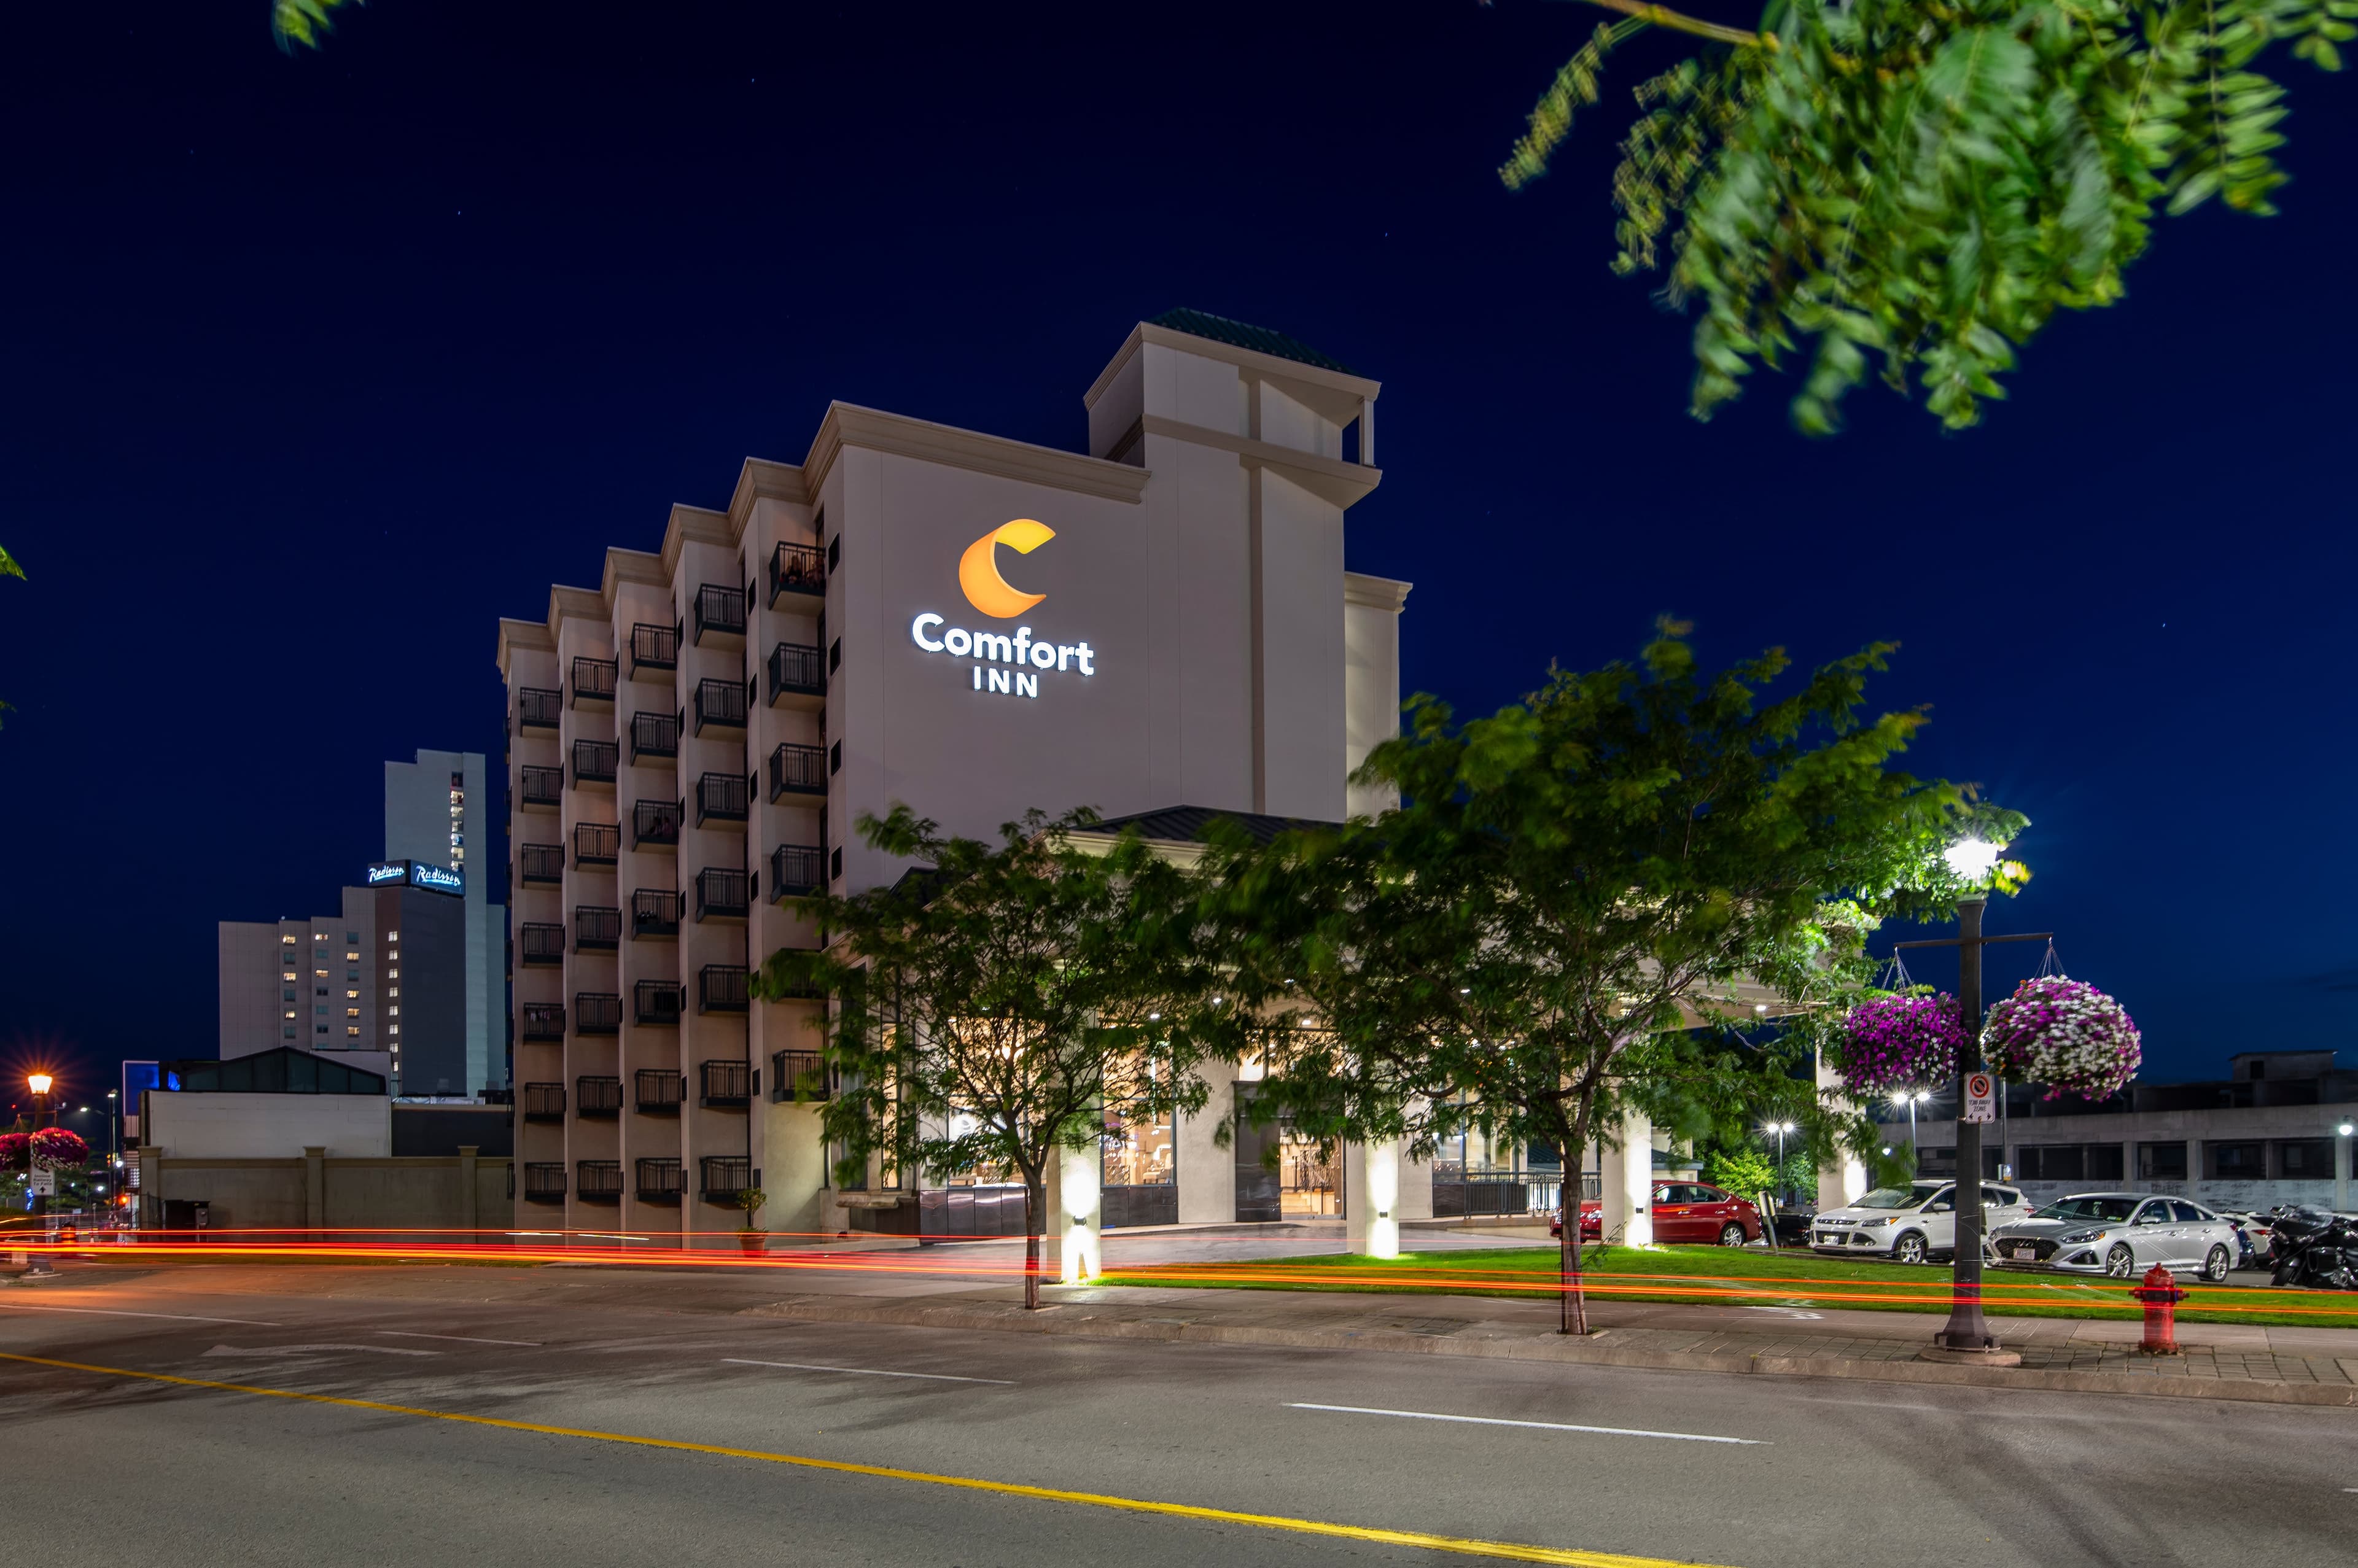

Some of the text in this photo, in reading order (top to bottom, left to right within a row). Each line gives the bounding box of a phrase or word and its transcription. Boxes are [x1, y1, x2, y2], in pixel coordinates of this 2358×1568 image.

[912, 613, 1095, 677] Comfort
[973, 666, 1038, 699] INN
[368, 864, 405, 883] Radisson
[416, 864, 461, 886] Radisson
